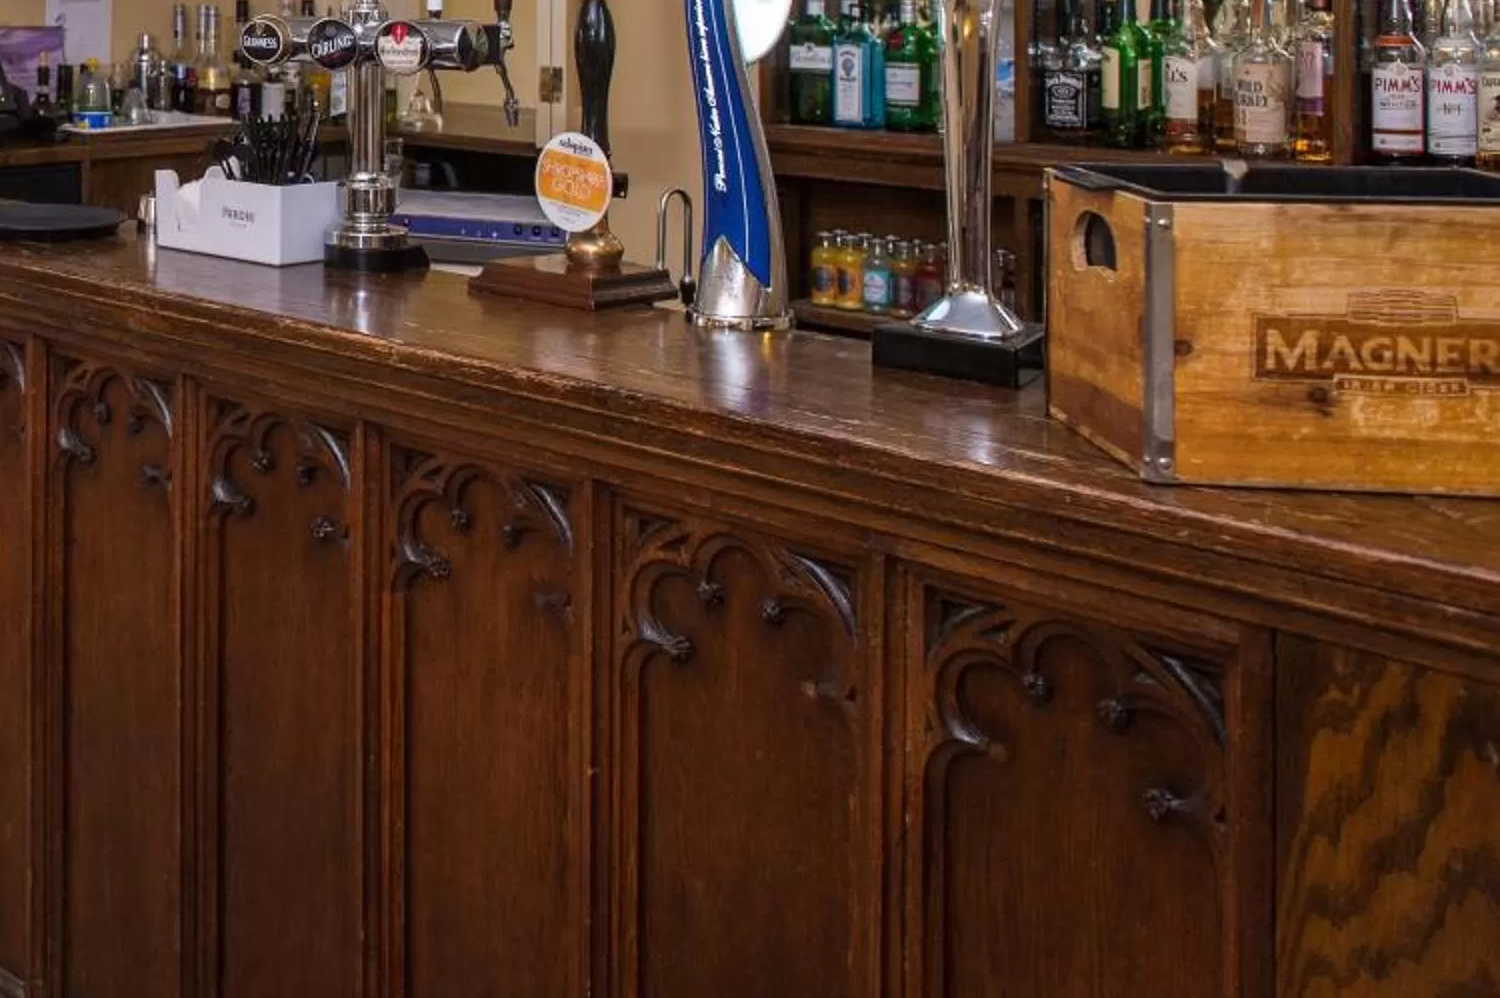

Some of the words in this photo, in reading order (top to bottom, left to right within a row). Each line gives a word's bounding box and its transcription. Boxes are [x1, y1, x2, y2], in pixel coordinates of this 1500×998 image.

[243, 34, 278, 49] GUINNESS
[311, 34, 354, 60] CARLING
[1375, 75, 1421, 93] PIMM'S
[1430, 77, 1476, 95] PIMM'S
[1264, 328, 1500, 374] MAGNER
